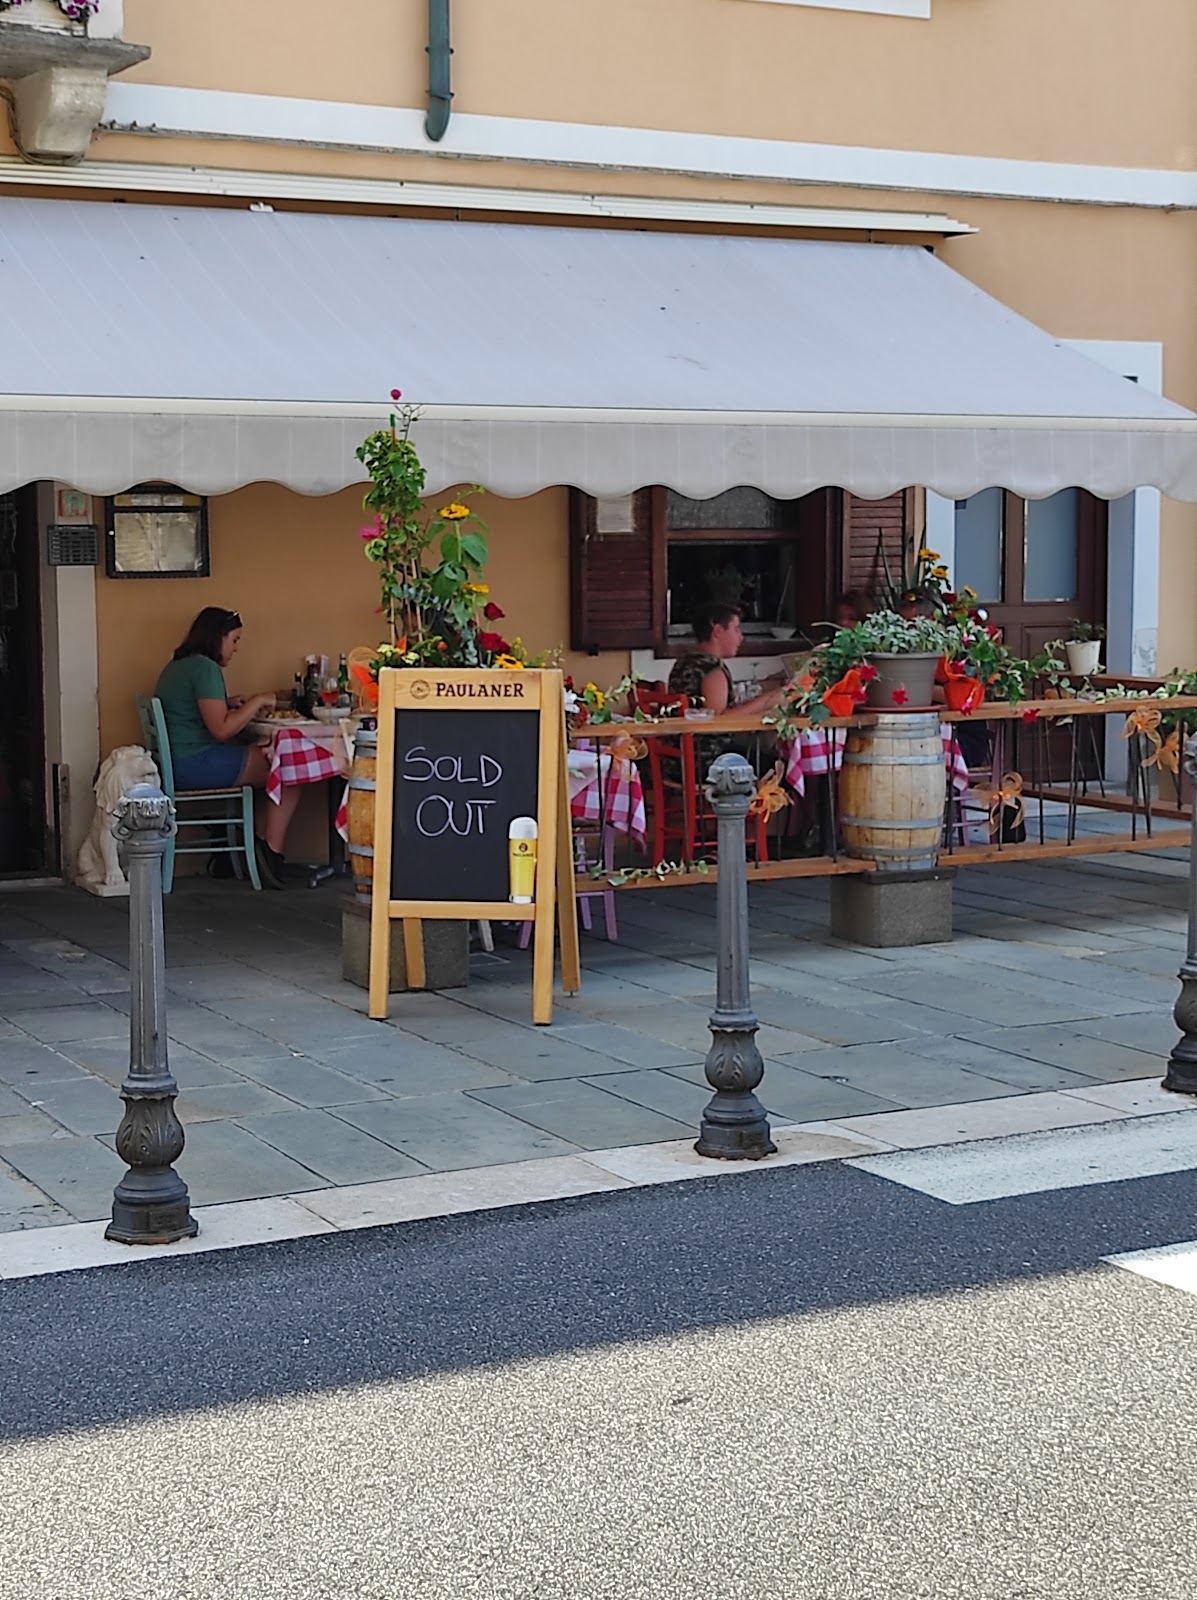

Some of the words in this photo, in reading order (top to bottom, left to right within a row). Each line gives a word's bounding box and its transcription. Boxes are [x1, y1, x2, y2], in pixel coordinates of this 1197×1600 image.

[436, 682, 524, 698] PAULANER
[403, 746, 502, 787] SOLD
[416, 794, 497, 837] OUT
